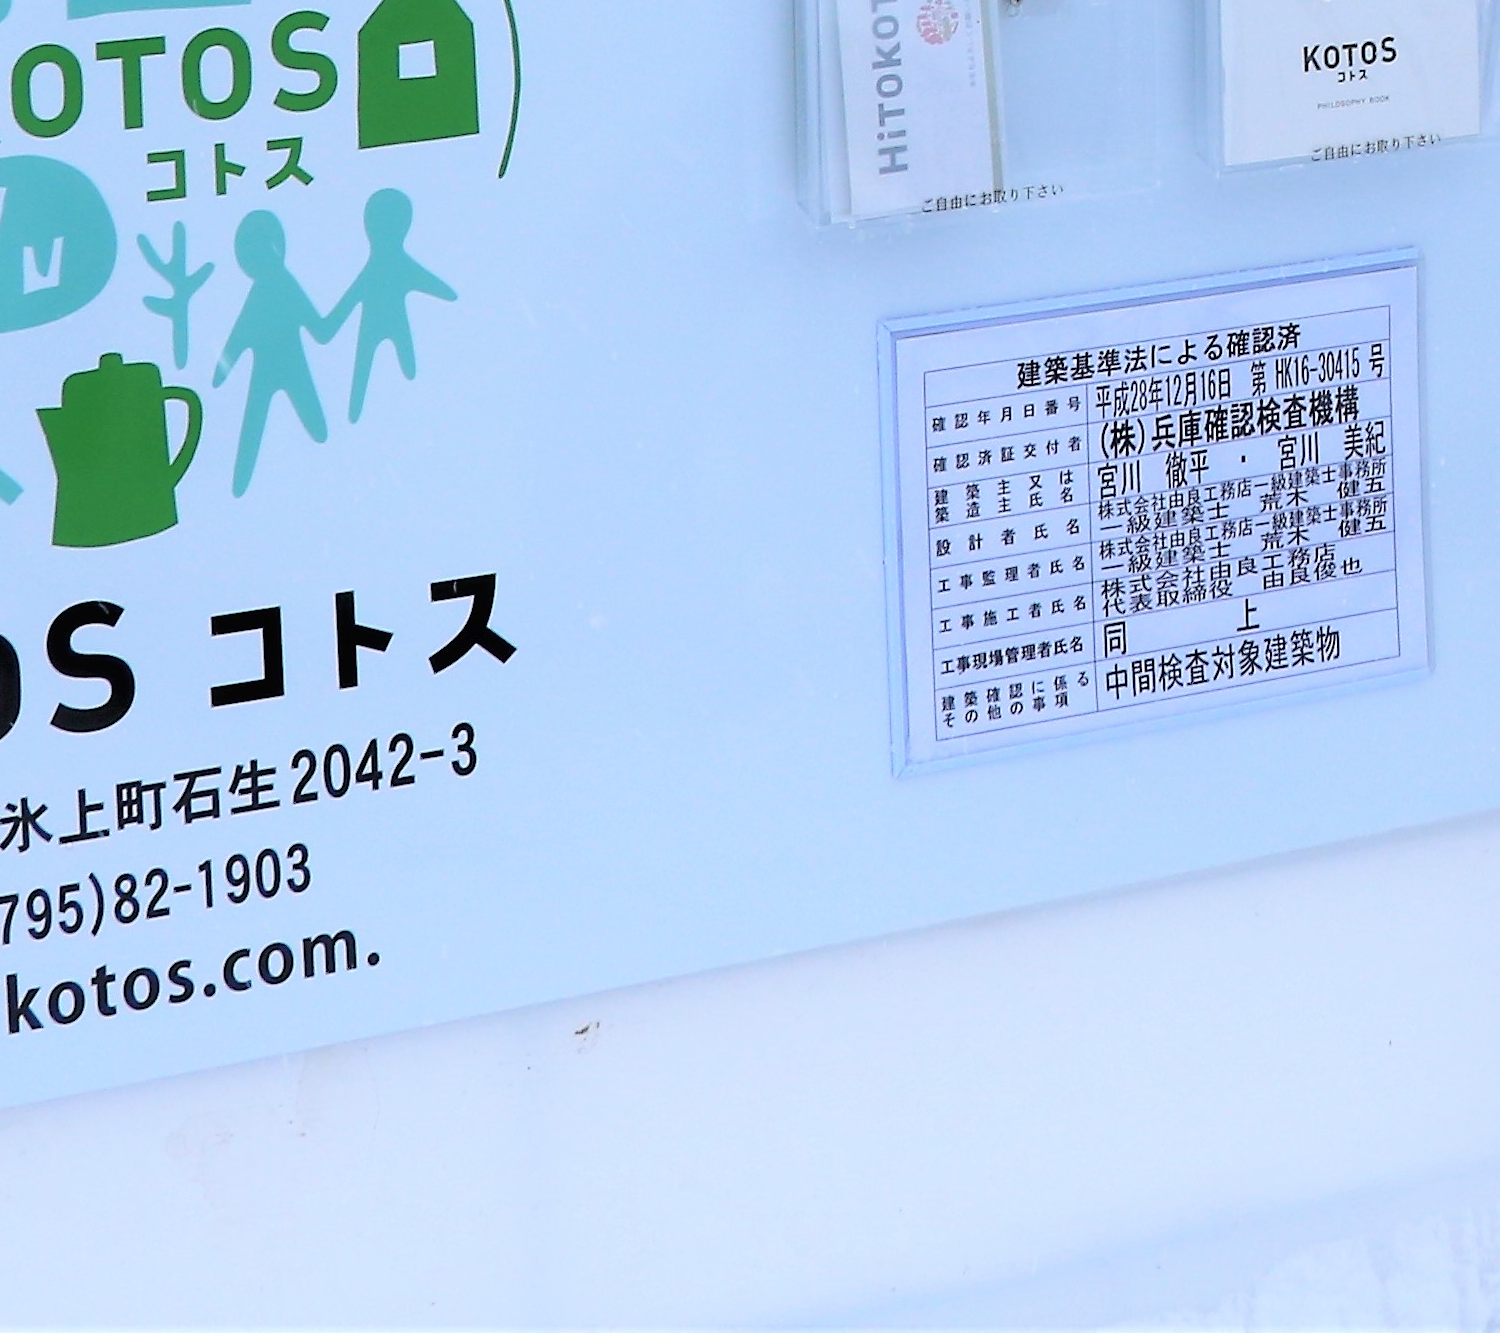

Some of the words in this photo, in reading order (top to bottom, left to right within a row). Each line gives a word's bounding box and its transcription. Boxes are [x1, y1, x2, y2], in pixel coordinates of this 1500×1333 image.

[1302, 36, 1398, 73] KOTOS
[1337, 69, 1369, 83] コトス
[146, 136, 315, 203] コトス
[1310, 133, 1442, 162] ご自由にお取り下さい
[921, 184, 1065, 213] ご自由にお取り下さい
[1017, 322, 1301, 389] 建築基準法による確認済
[1095, 368, 1231, 419] 平成28年12月16日
[1250, 360, 1268, 396] 第
[1275, 347, 1360, 390] HK16-30415
[1368, 342, 1386, 378] 号
[932, 396, 1081, 432] 確認年月日番号
[933, 436, 1082, 472] 確認済証交付者
[1097, 459, 1142, 500] 宮川
[1165, 448, 1210, 490] 徹平
[1277, 431, 1320, 471] 宮川
[1344, 420, 1386, 460] 美紀
[1098, 460, 1387, 520] 株式会社由良工務店一級建築士事務所
[1100, 502, 1230, 535] 一級建築士
[1260, 488, 1309, 514] 荒木
[1099, 495, 1388, 560] 株式会社由良工務店一級建築士事務所
[1101, 541, 1231, 574] 一級建築士
[1261, 526, 1310, 553] 荒木
[937, 555, 1085, 593] 工事監理者氏名
[1101, 543, 1336, 599] 株式会社由良工務店
[939, 595, 1087, 633] 工事施工者氏名
[1102, 581, 1233, 618] 代表取締役
[208, 572, 519, 708] コトス
[940, 635, 1084, 675] 工事現場管理者氏名
[1105, 625, 1341, 700] 中間検査対象建築物
